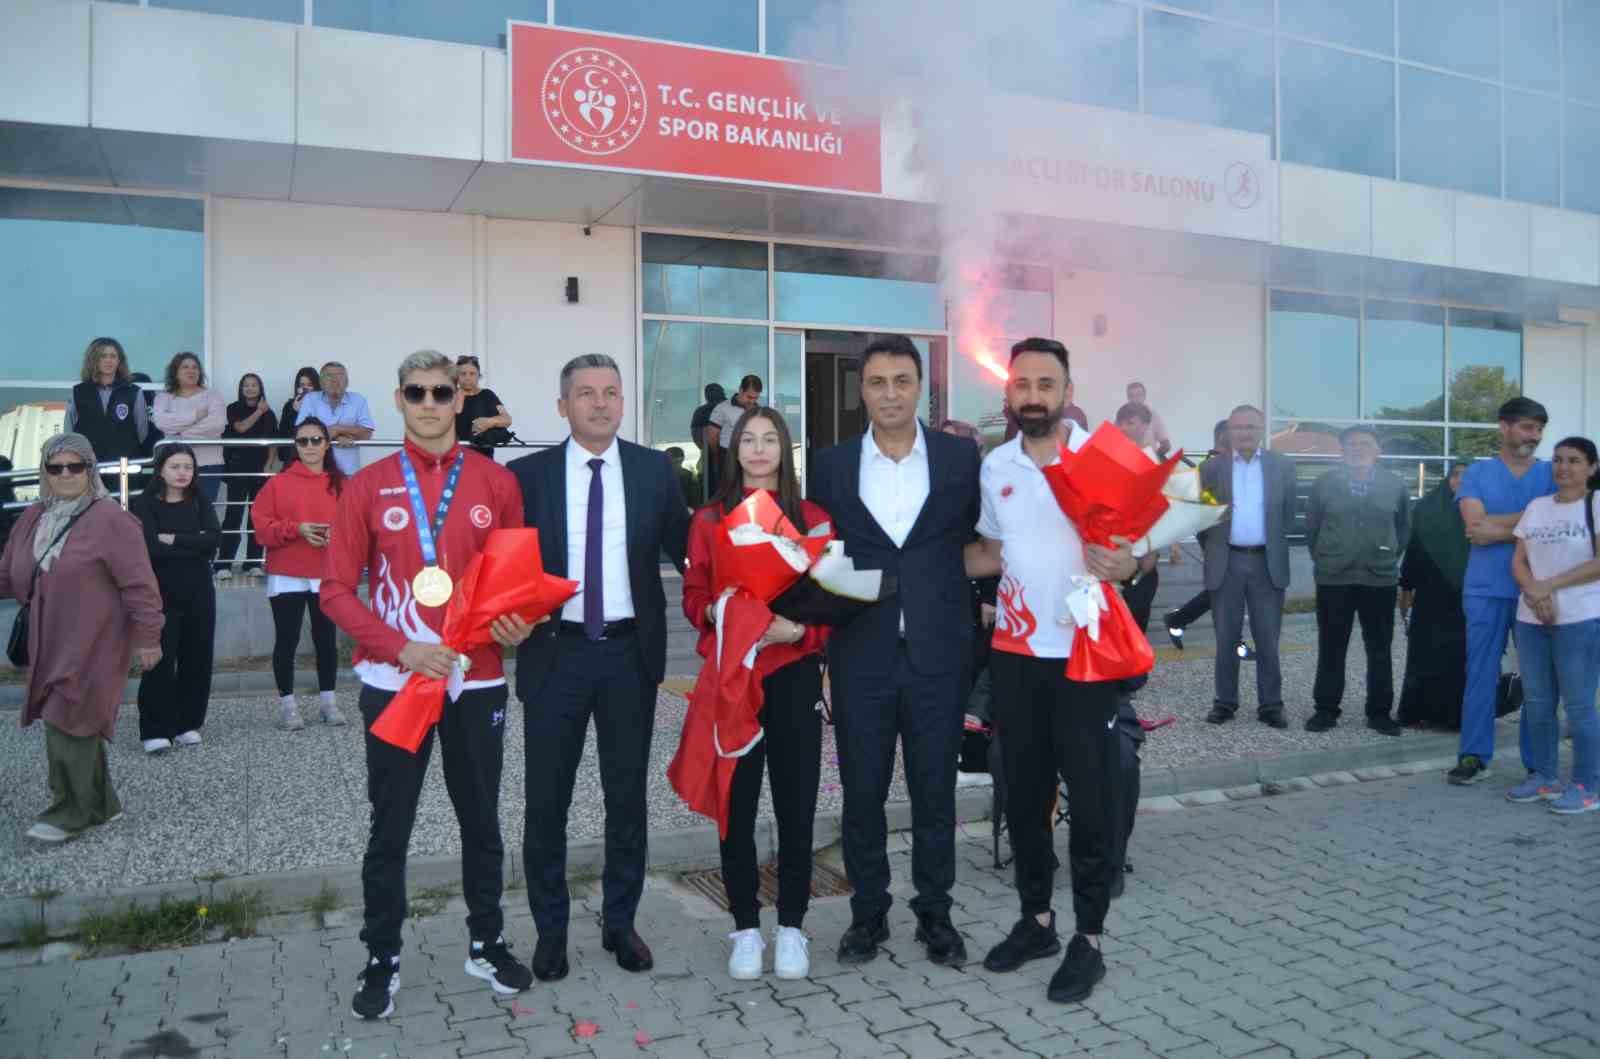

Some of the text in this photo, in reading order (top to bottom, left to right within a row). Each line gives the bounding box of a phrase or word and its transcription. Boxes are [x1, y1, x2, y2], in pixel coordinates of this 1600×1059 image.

[656, 84, 842, 125] T.C. GENÇLİK VE
[657, 116, 843, 156] SPOR BAKANLIĞI
[1131, 171, 1216, 204] SALONU
